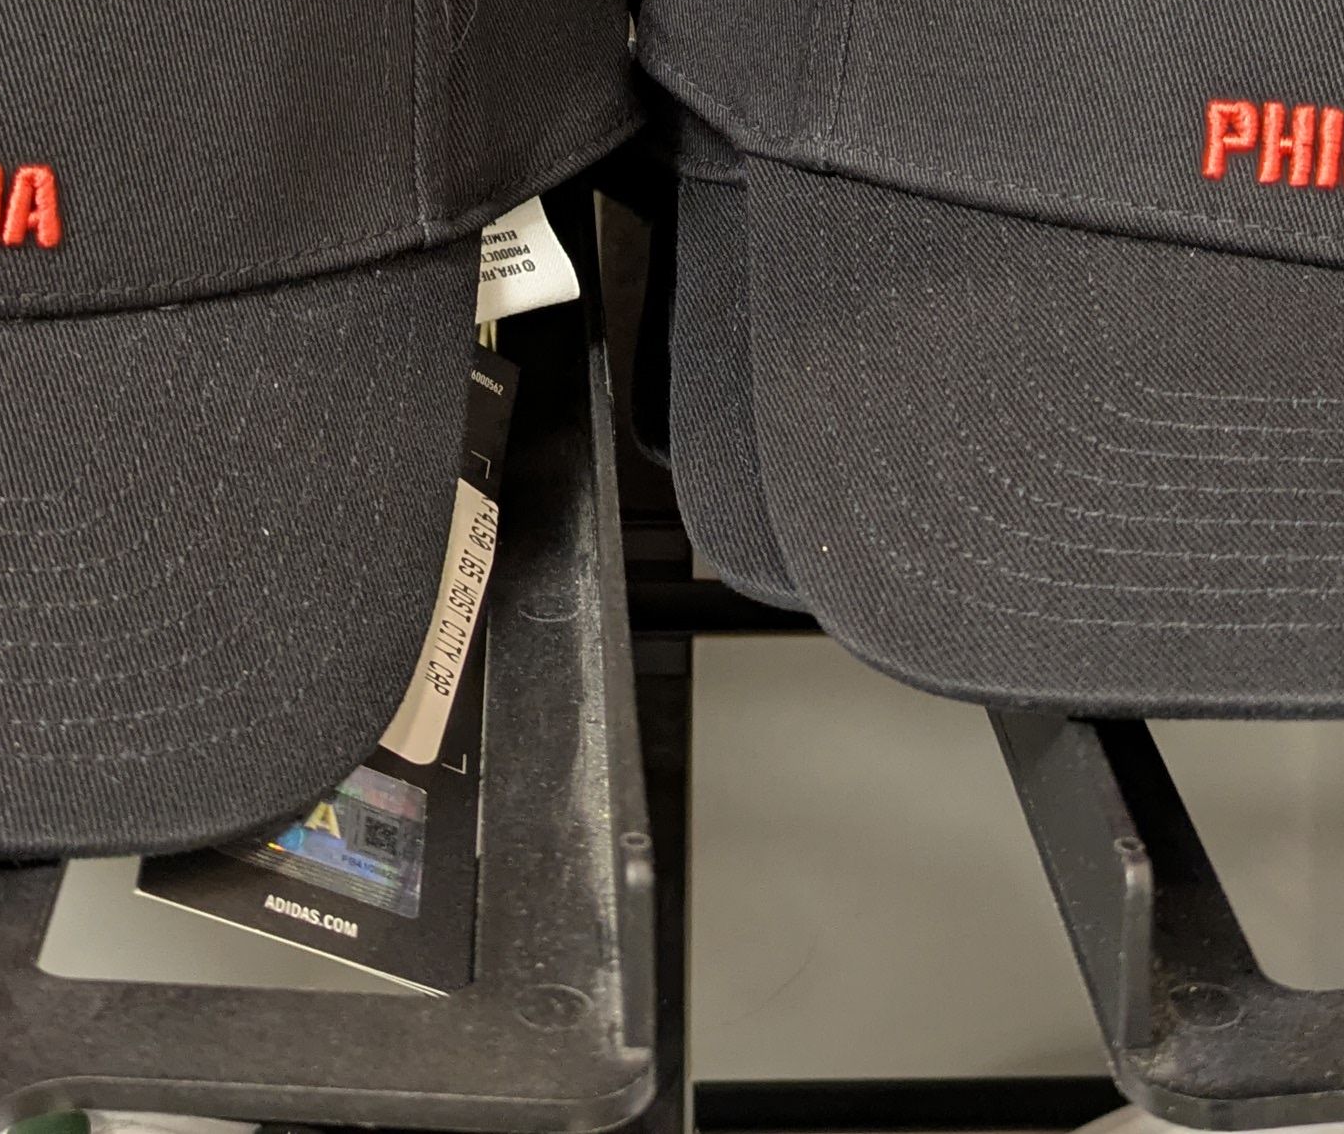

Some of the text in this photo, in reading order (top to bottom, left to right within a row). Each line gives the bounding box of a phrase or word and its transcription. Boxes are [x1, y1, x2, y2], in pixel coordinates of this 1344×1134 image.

[458, 548, 486, 585] 165
[446, 578, 479, 624] HOST
[434, 618, 468, 665] CITY
[425, 659, 455, 698] CAP
[264, 894, 359, 938] ADIDAS.COM
